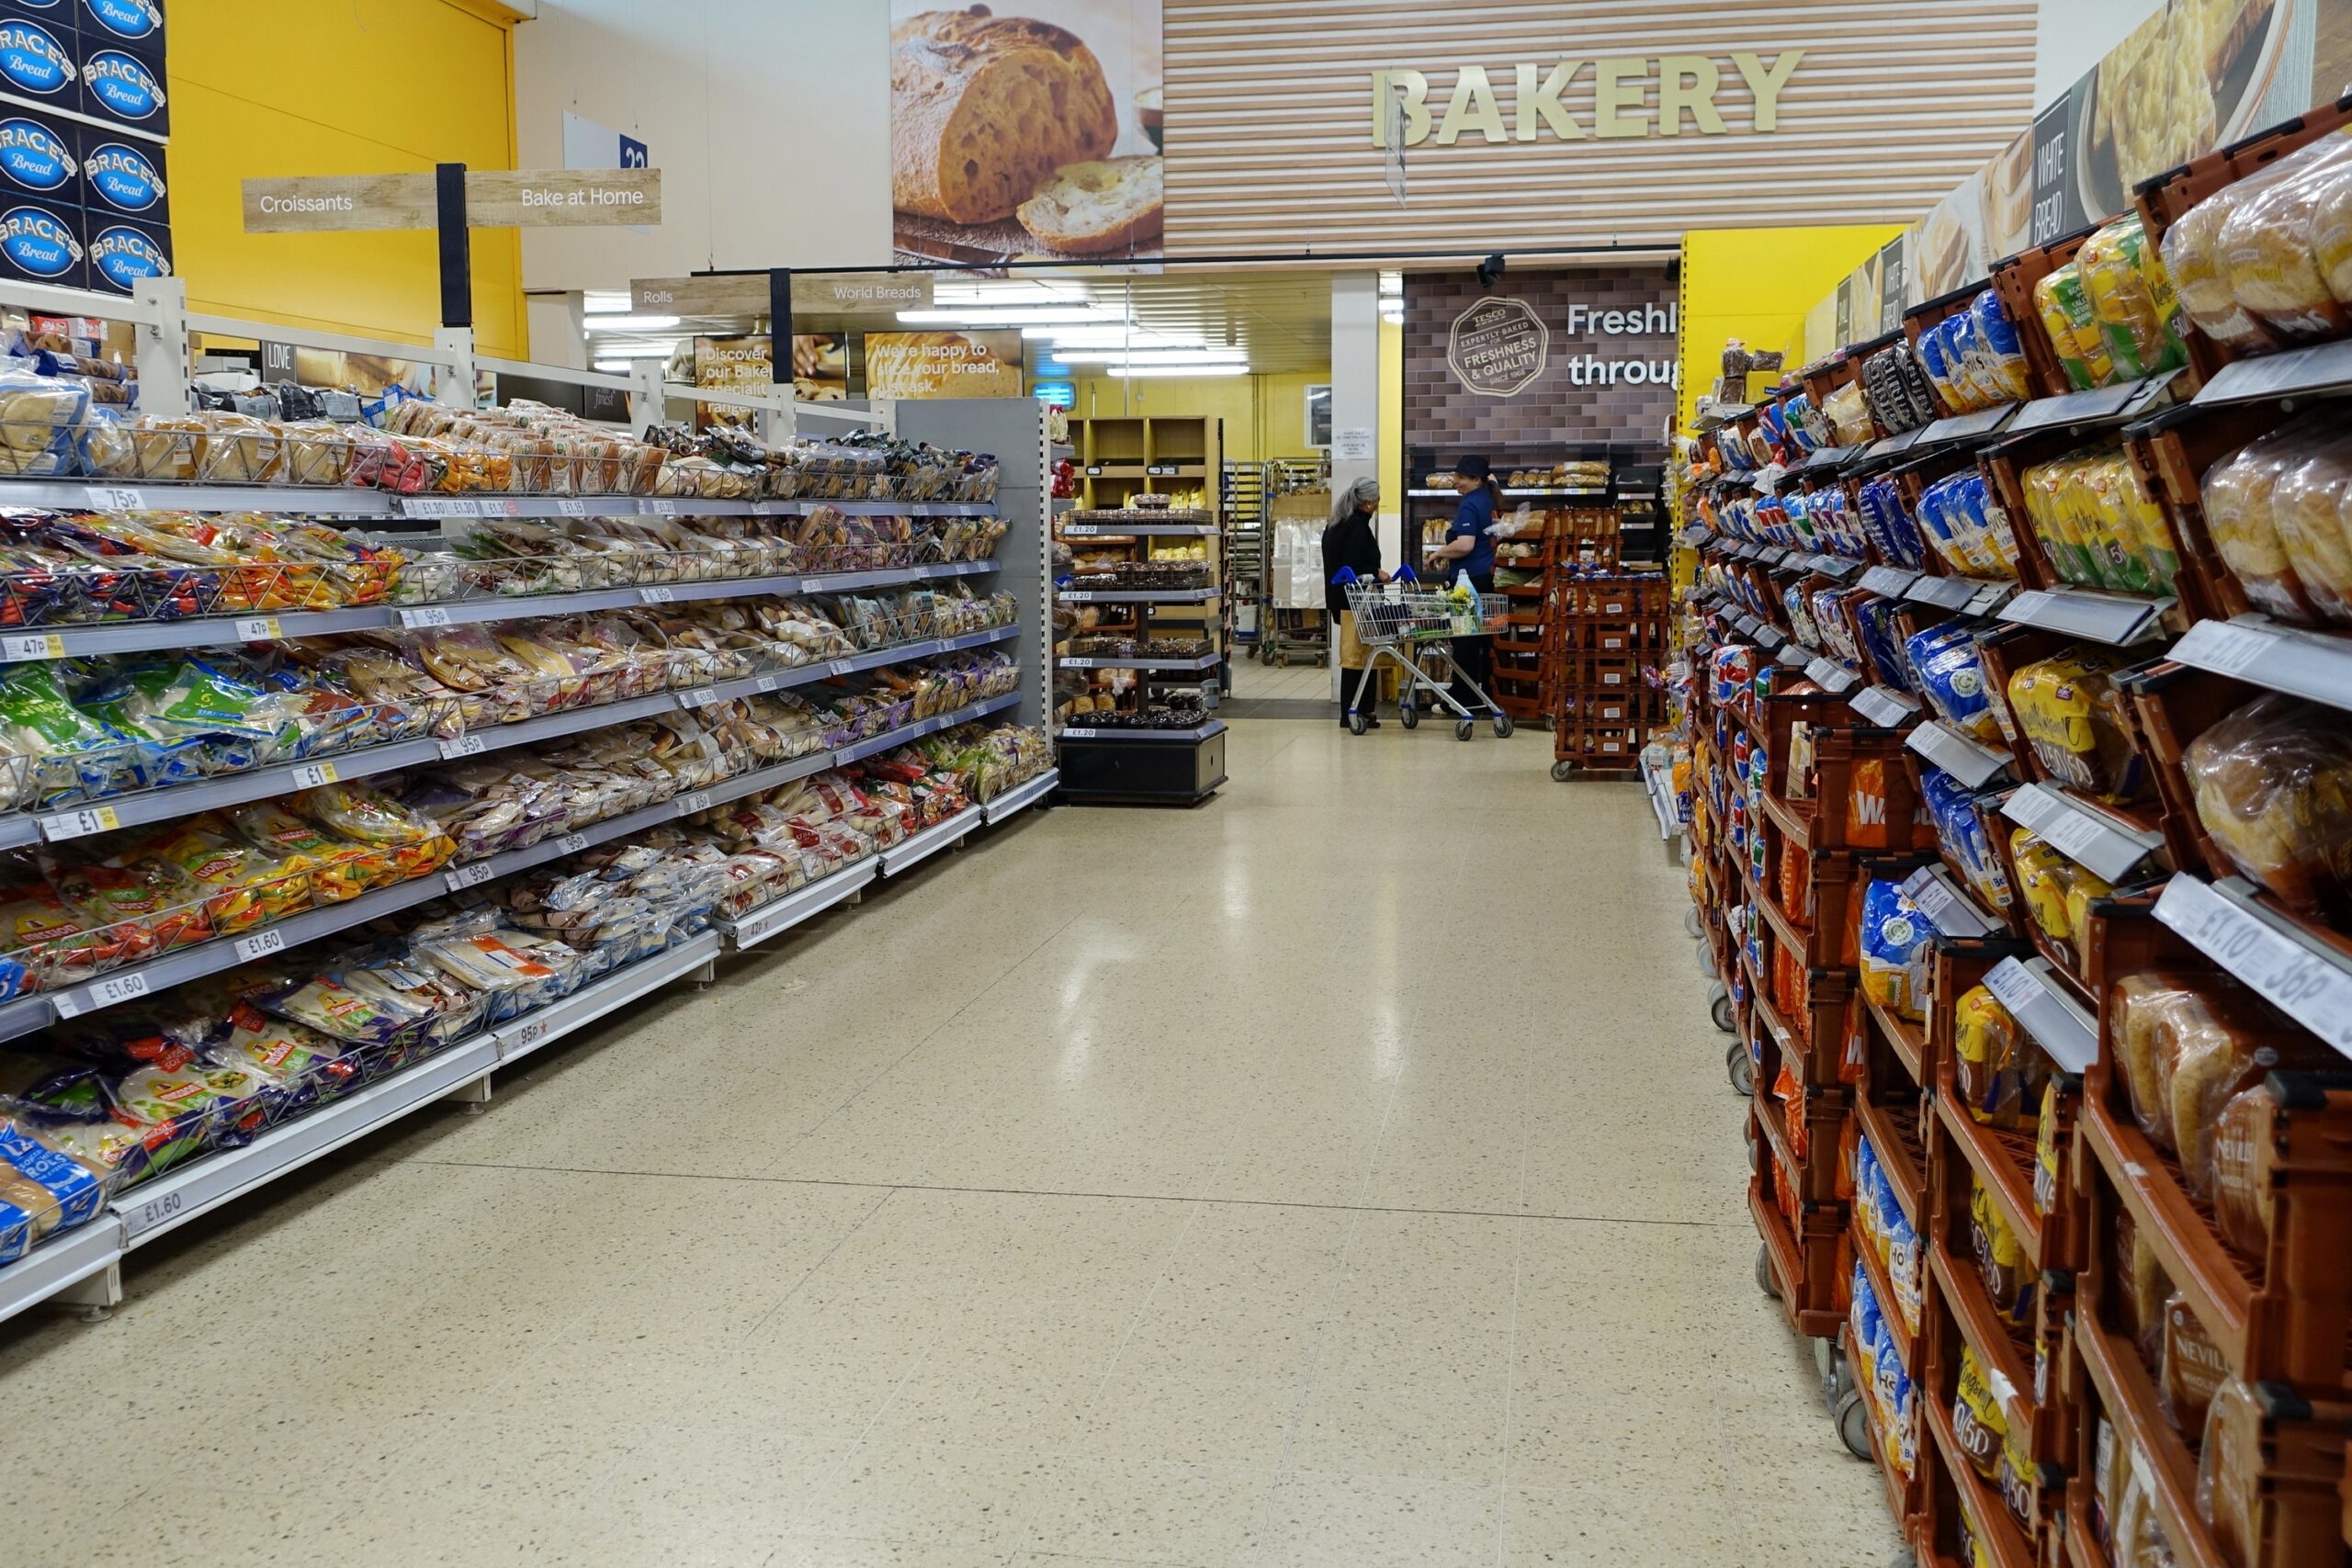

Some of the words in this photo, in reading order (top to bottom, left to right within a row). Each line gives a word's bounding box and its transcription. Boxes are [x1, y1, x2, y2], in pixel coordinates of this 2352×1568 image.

[101, 1, 140, 25] Bread
[0, 29, 77, 81] RACE'S
[9, 54, 51, 79] Bread
[82, 60, 166, 107] BRACE'S
[106, 83, 144, 106] Bread
[1372, 50, 1807, 148] BAKERY
[0, 128, 77, 177] RACE'S
[2037, 131, 2064, 190] WHITE
[11, 152, 52, 176] Bread
[85, 152, 166, 198] BRACE'S
[107, 175, 143, 197] Bread
[260, 195, 353, 213] Croissants
[522, 189, 563, 207] Bake
[568, 190, 585, 205] at
[591, 187, 643, 205] Home
[2034, 190, 2063, 245] BREAD
[18, 241, 59, 263] Bread
[89, 234, 172, 277] BRACE'S
[112, 258, 149, 277] Bread
[643, 290, 673, 304] Rolls
[834, 286, 873, 299] World
[876, 286, 921, 299] Breads
[1472, 309, 1507, 325] TESCO
[1567, 301, 1679, 334] Freshl
[1460, 331, 1499, 347] EXPERTLY
[1501, 321, 1529, 335] BAKED
[268, 344, 291, 370] LOVE
[706, 345, 768, 361] Discover
[876, 344, 918, 357] We're
[922, 344, 967, 361] happy
[970, 344, 987, 356] to
[1464, 337, 1536, 368] FRESHNESS
[706, 367, 731, 378] our
[734, 366, 774, 378] Baker
[952, 360, 1000, 375] bread,
[1471, 369, 1481, 379] &
[1483, 351, 1536, 376] QUALITY
[909, 379, 937, 392] ask.
[1489, 373, 1509, 385] SINCE
[106, 491, 137, 508] 75p
[423, 502, 446, 515] £1.30
[454, 502, 476, 514] £1.30
[425, 610, 445, 625] 95p
[252, 623, 267, 636] 47p
[25, 639, 45, 654] 47p
[459, 738, 481, 752] 95p
[308, 766, 324, 784] £1
[79, 811, 98, 832] £1
[566, 837, 583, 851] 95p
[469, 866, 489, 882] 95p
[249, 931, 279, 954] £1.60
[2198, 907, 2261, 959] £1.10
[105, 976, 143, 999] £1.60
[521, 1025, 538, 1044] 95p
[146, 1192, 181, 1223] £1.60
